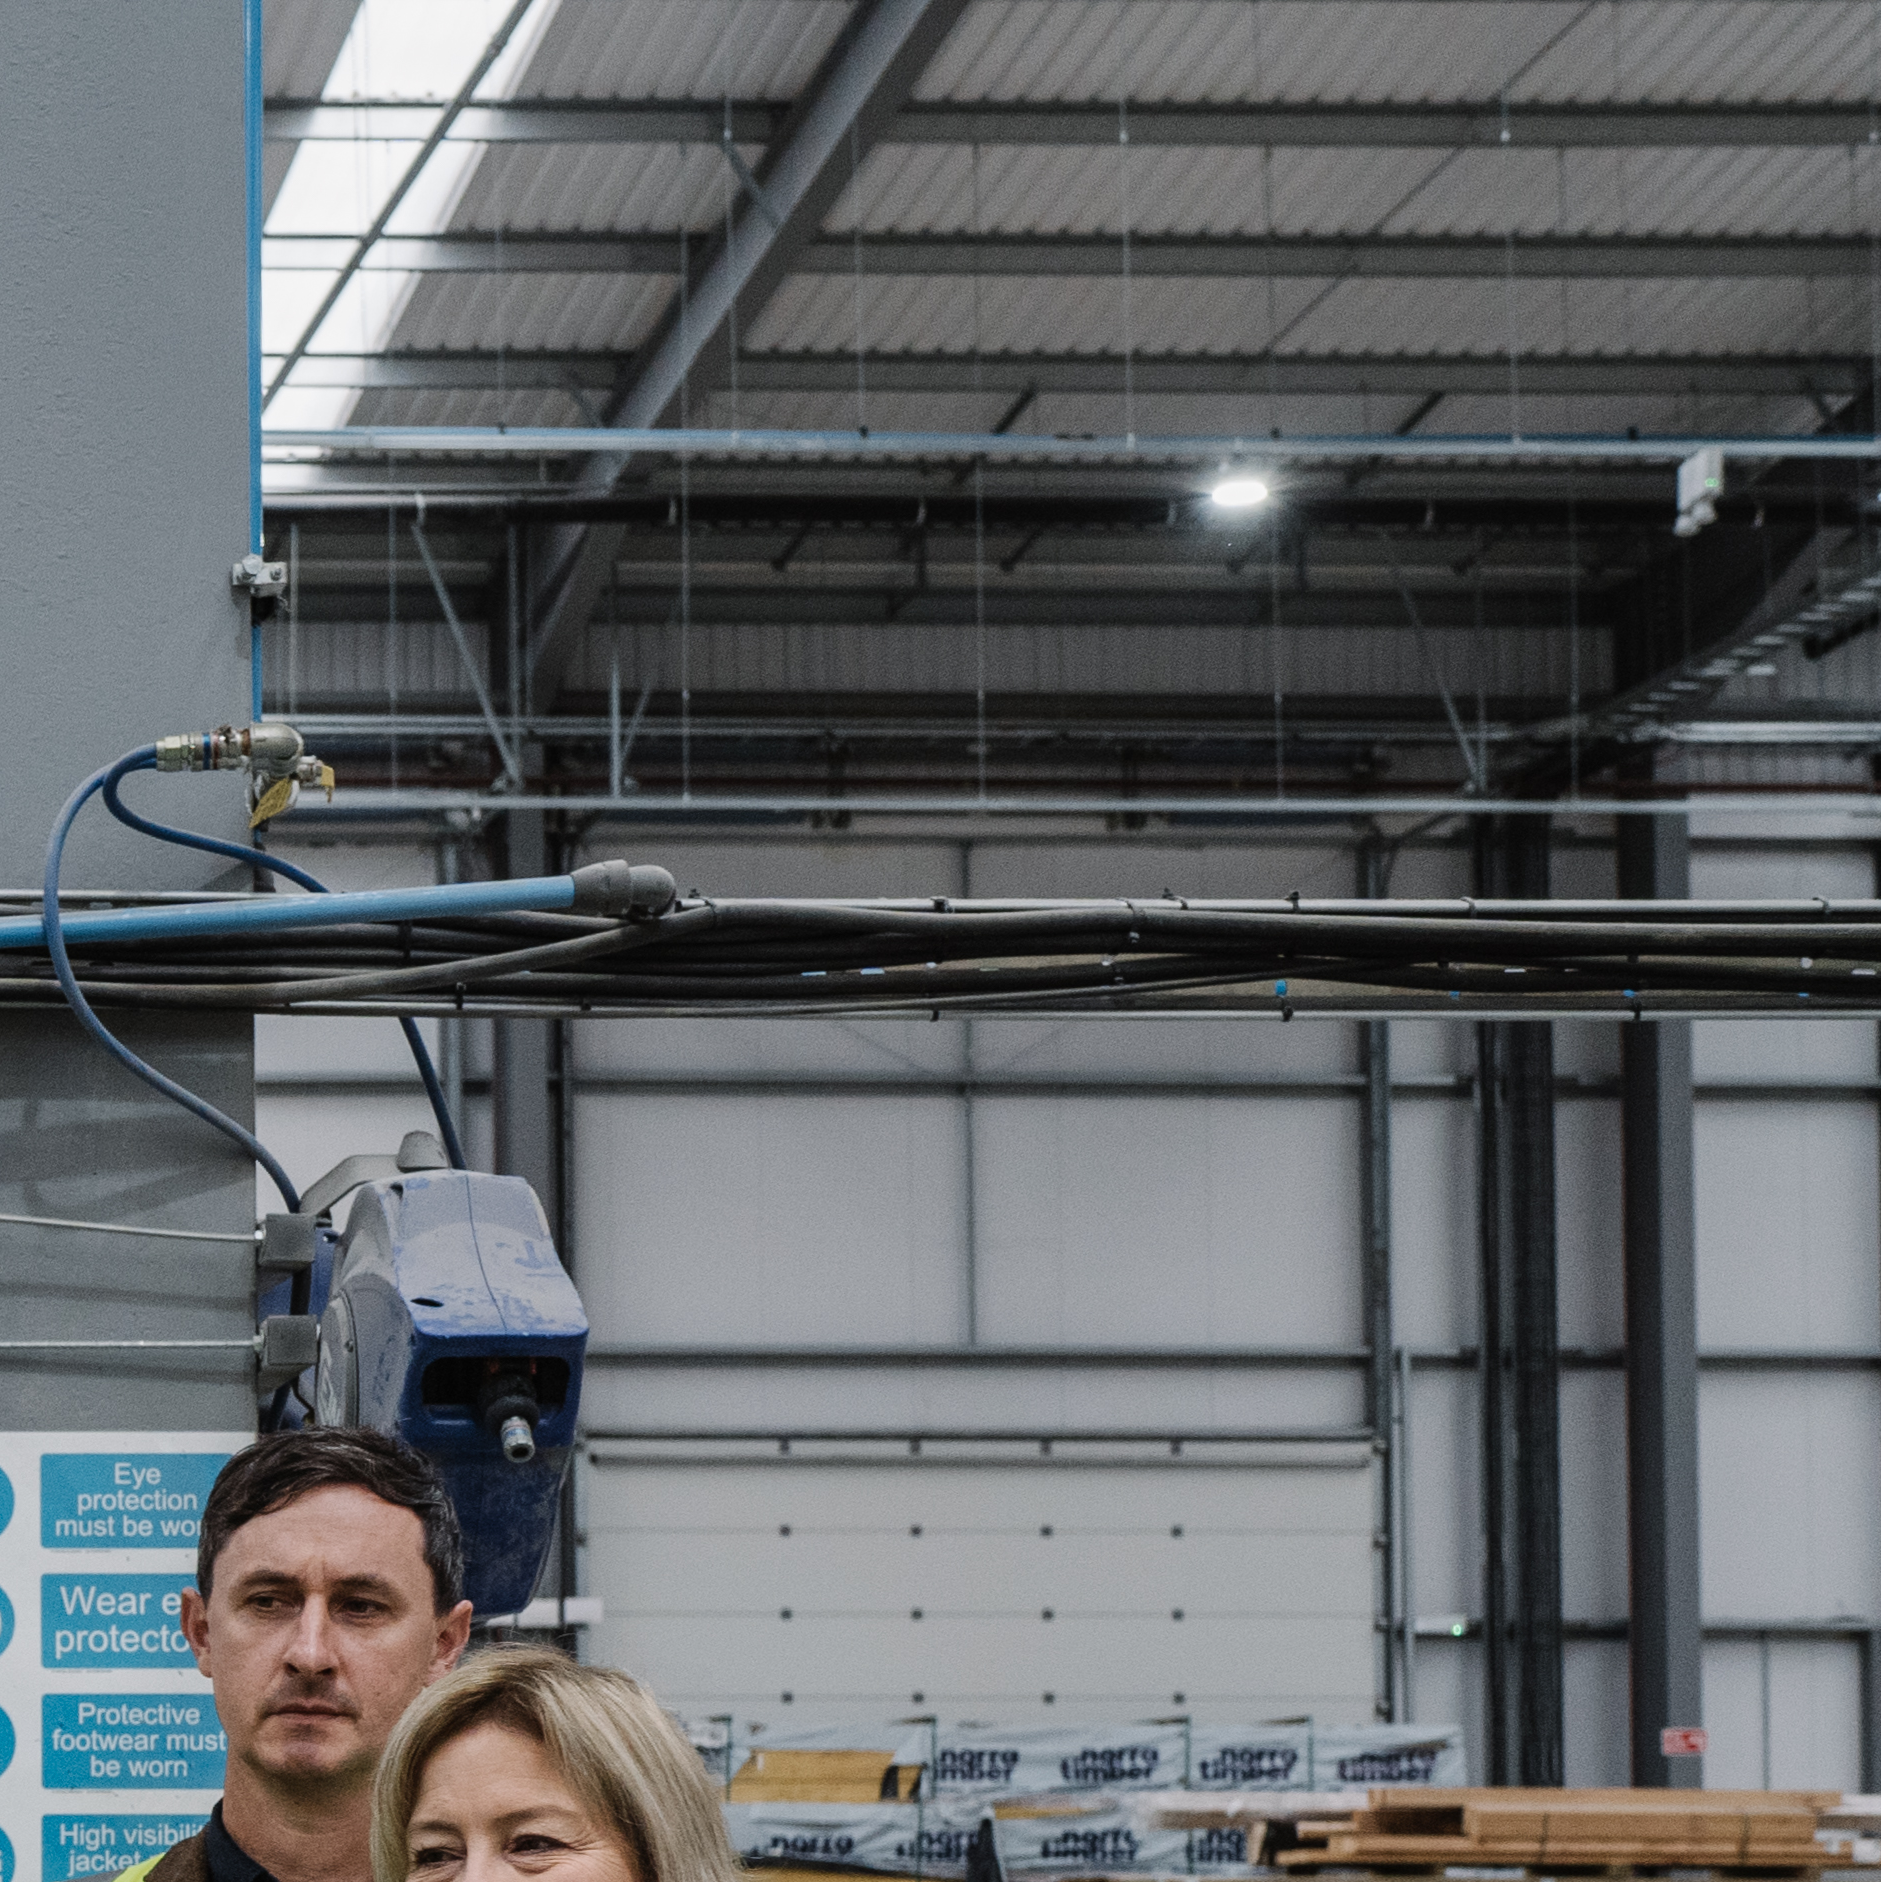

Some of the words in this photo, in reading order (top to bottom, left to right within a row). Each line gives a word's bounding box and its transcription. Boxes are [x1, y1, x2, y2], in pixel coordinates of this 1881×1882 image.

[114, 1462, 162, 1489] Eye
[77, 1489, 198, 1516] protection
[55, 1516, 115, 1537] must
[122, 1514, 154, 1537] be
[160, 1520, 202, 1537] wor
[60, 1585, 152, 1616] Wear
[55, 1624, 190, 1661] protecto
[77, 1703, 201, 1725] Protective
[52, 1728, 159, 1751] footwear
[166, 1730, 228, 1751] must
[90, 1755, 121, 1777] be
[127, 1760, 188, 1777] worn
[59, 1823, 116, 1851] High
[123, 1823, 204, 1846] visibili
[67, 1850, 141, 1877] jacket
